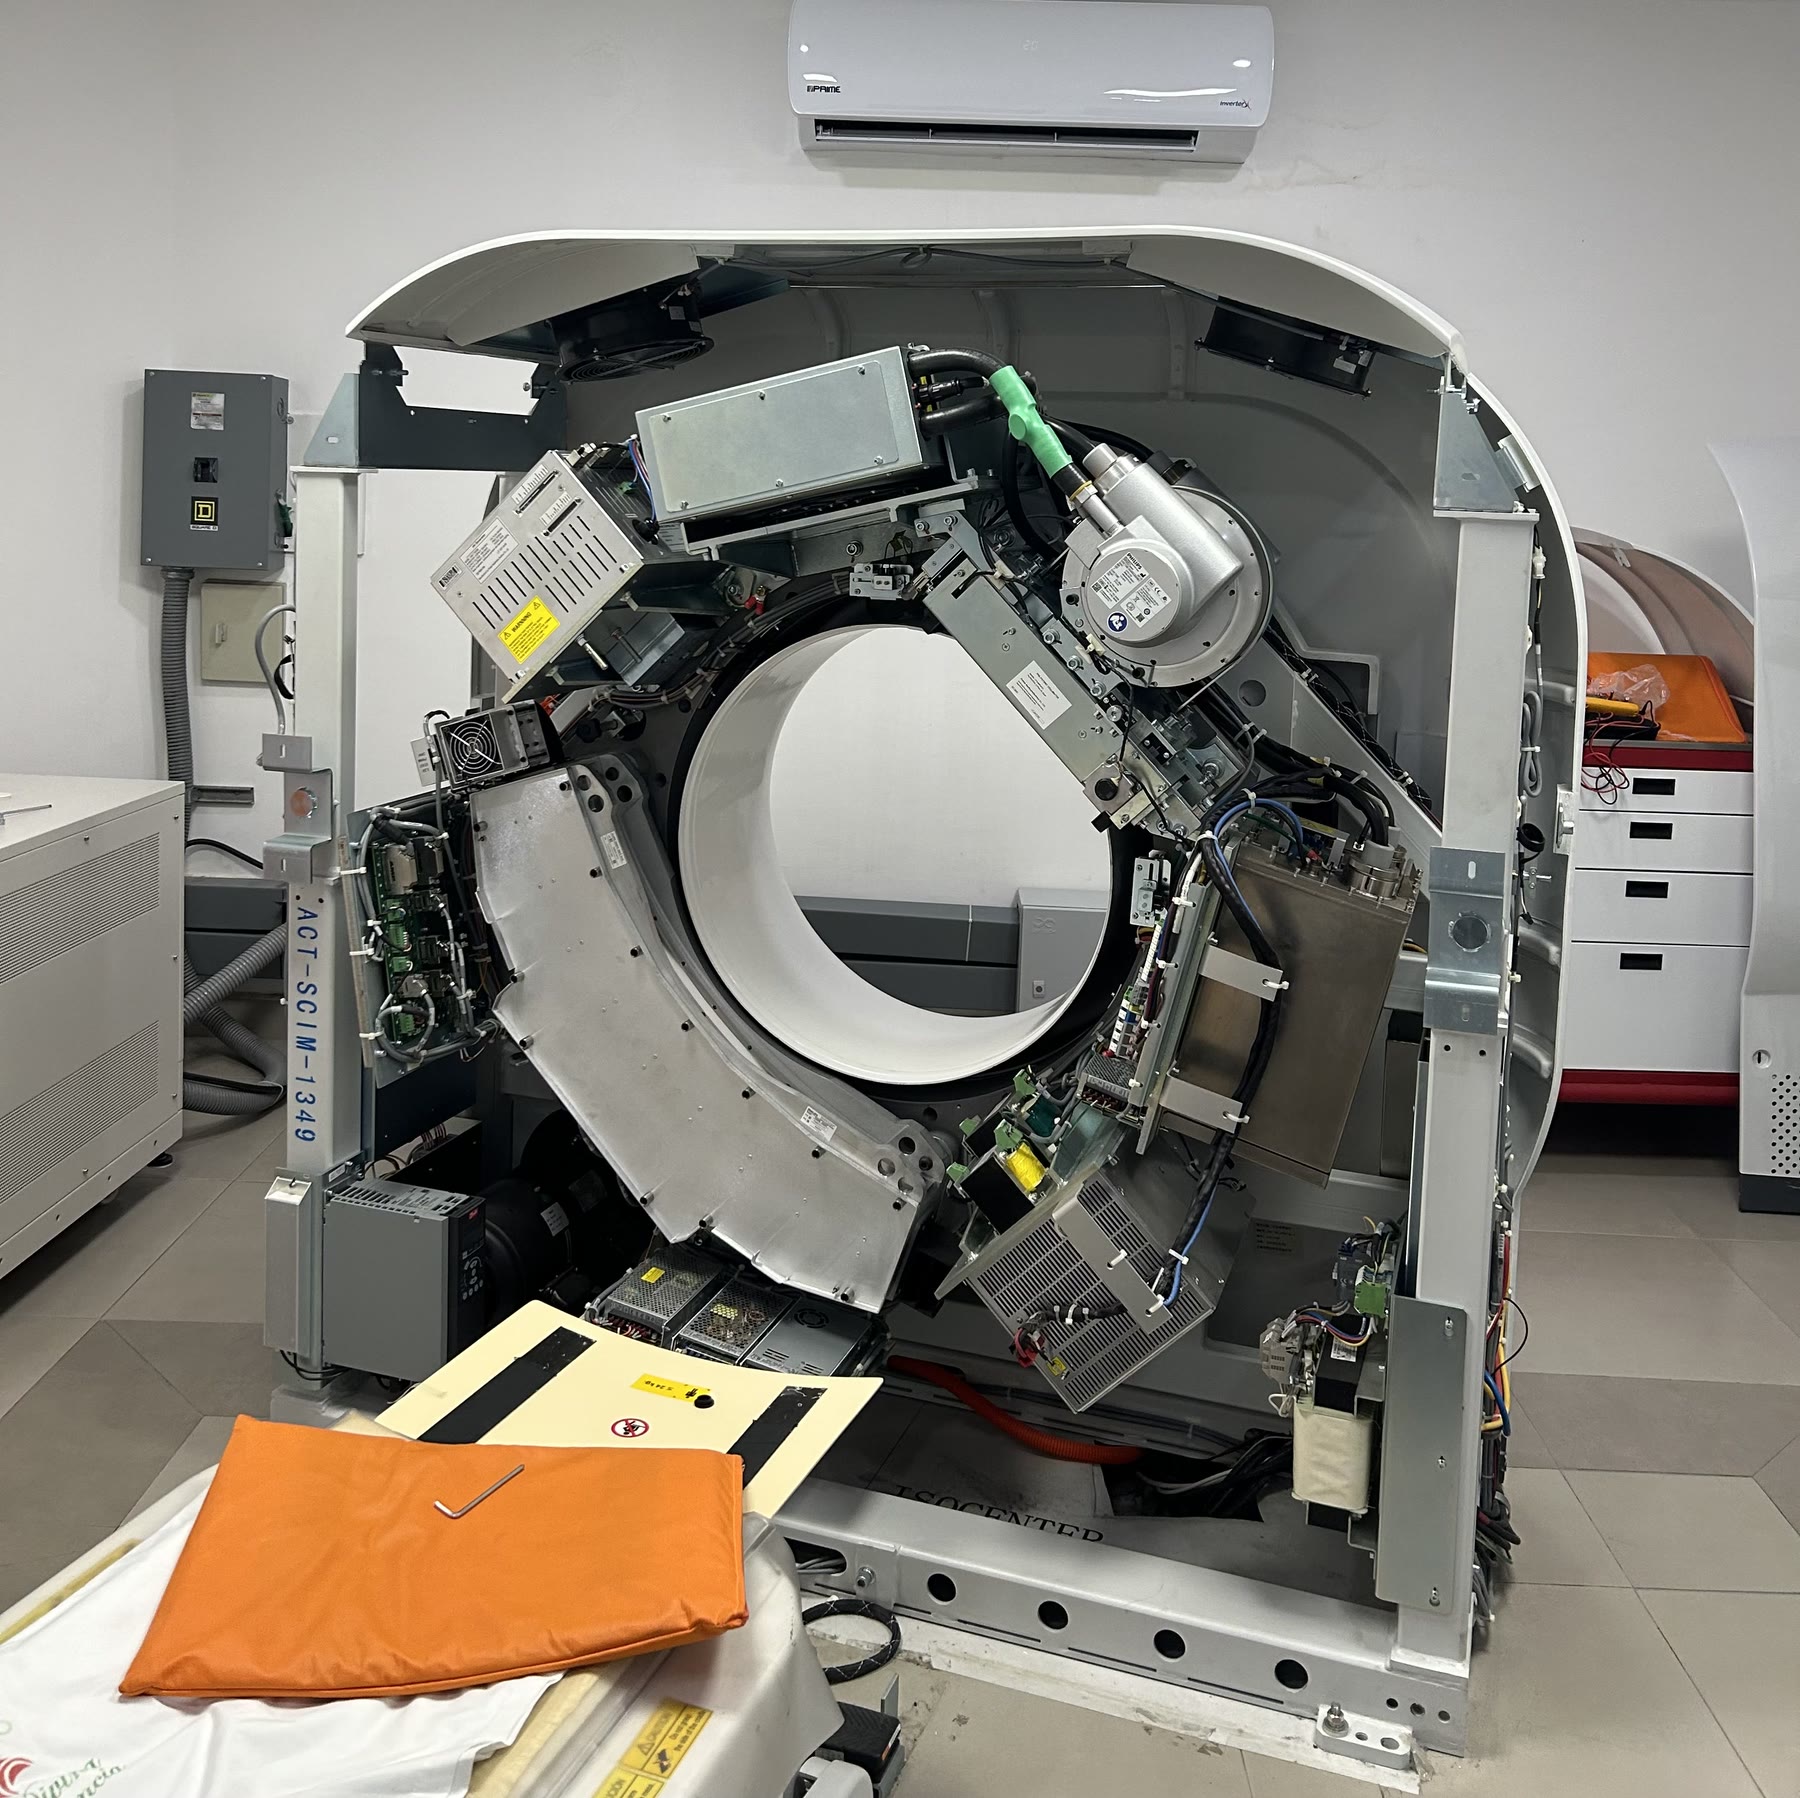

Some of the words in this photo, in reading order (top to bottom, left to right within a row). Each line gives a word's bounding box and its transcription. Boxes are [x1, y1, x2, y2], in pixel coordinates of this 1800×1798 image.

[1127, 553, 1142, 570] PHILIPS
[511, 611, 532, 632] WARNING
[295, 907, 319, 1142] ACT-SCIM-1349
